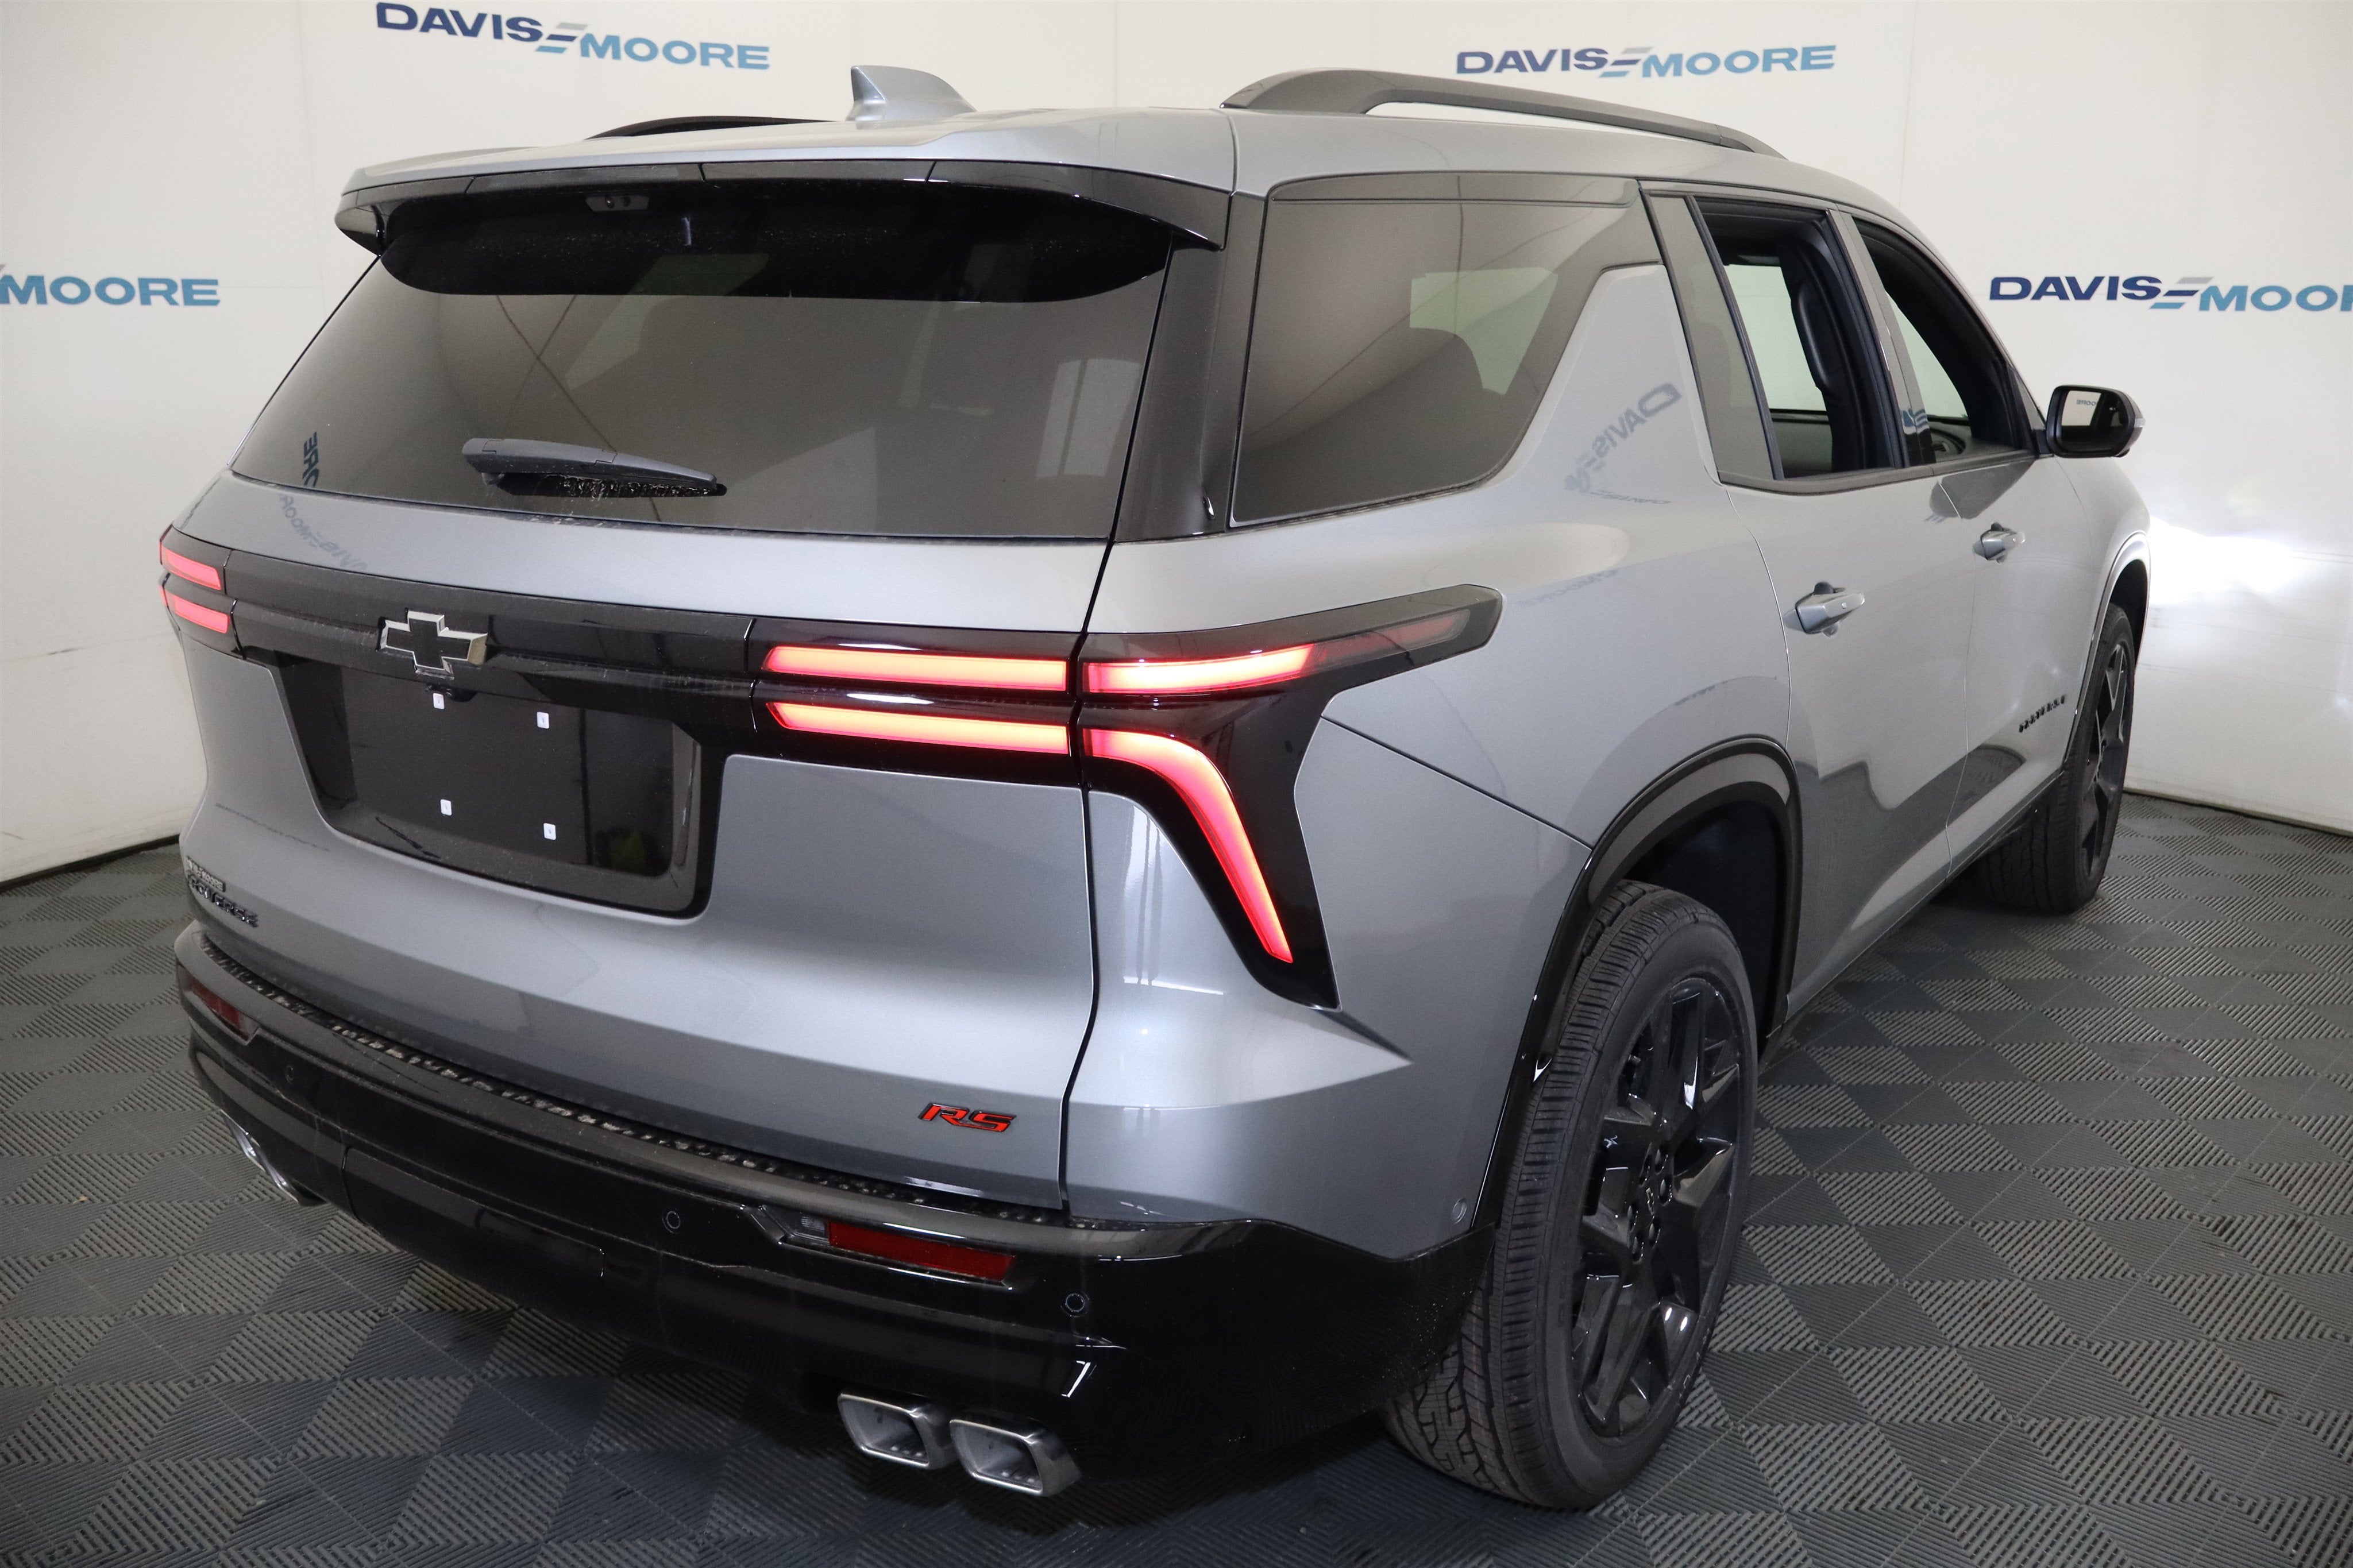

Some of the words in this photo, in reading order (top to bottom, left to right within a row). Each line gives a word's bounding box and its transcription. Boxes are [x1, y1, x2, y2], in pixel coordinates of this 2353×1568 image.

[377, 2, 543, 43] DAVIS
[580, 33, 770, 70] MOORE
[1456, 48, 1608, 75] DAVIS
[1642, 45, 1836, 78] MOORE
[0, 274, 221, 306] MOORE
[1989, 276, 2162, 301] DAVIS
[2197, 284, 2353, 312] MOO
[917, 1102, 1017, 1133] RS
